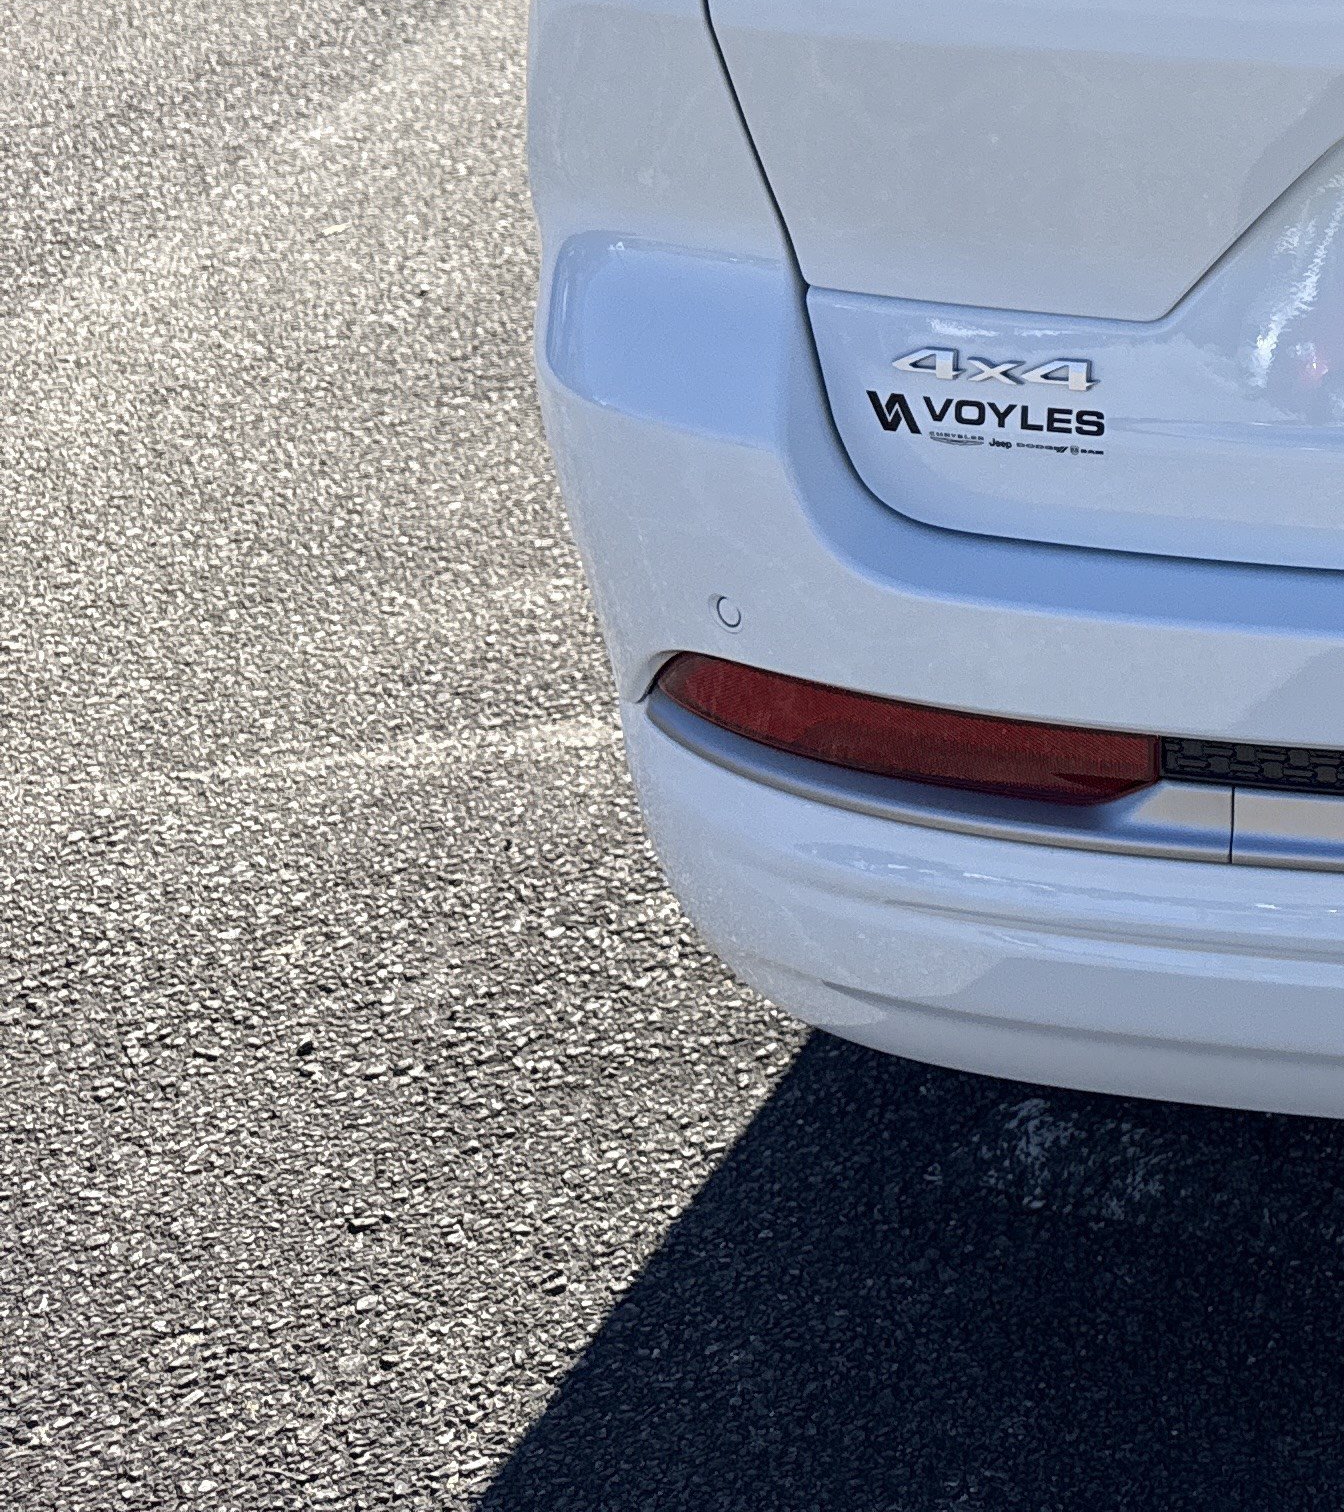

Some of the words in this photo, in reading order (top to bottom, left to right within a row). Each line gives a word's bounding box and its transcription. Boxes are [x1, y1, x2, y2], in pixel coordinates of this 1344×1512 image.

[891, 345, 1101, 392] 4x4
[922, 395, 1106, 437] VOYLES
[989, 438, 1012, 449] Jeep
